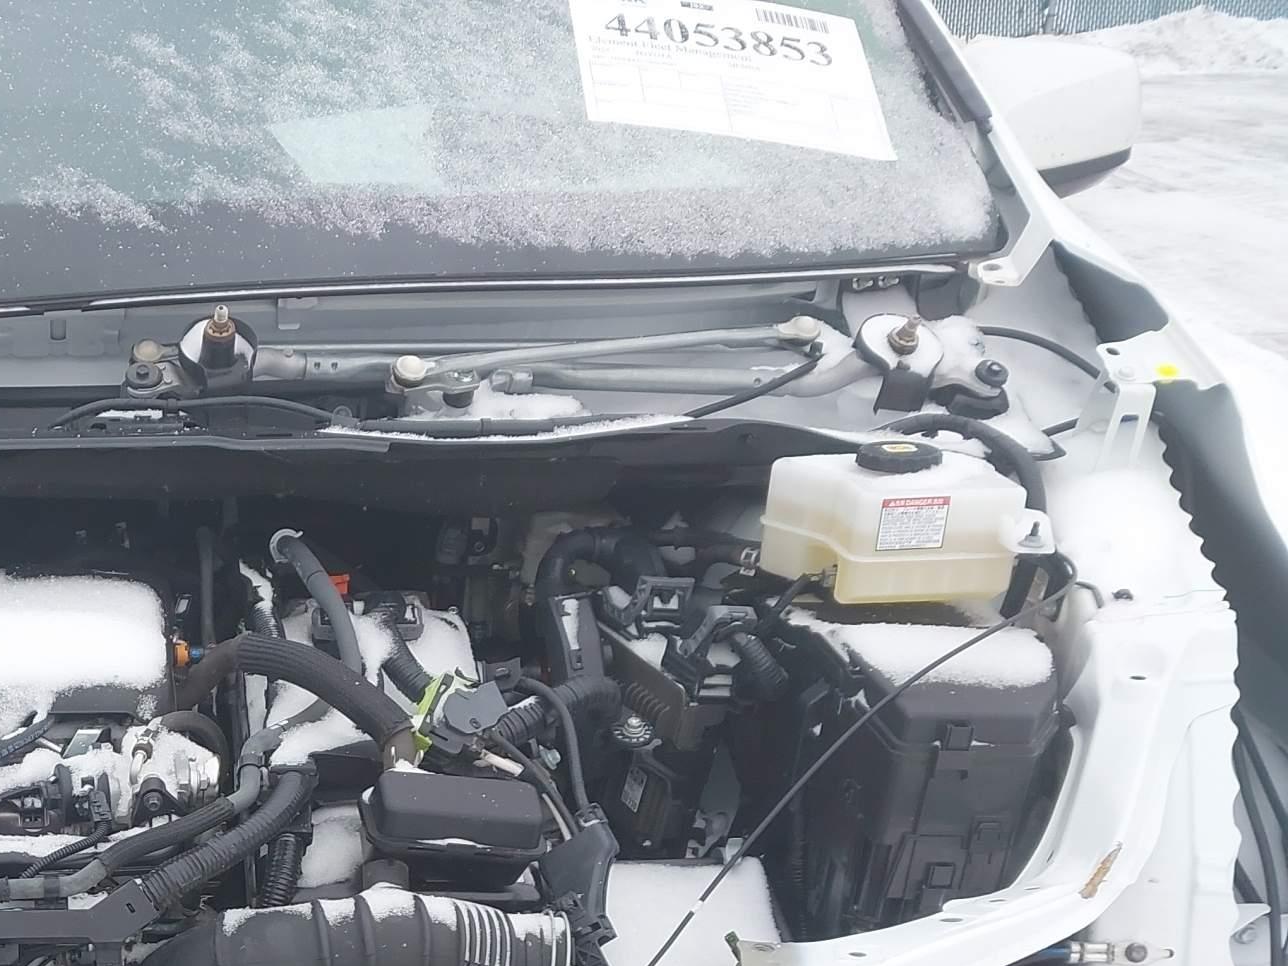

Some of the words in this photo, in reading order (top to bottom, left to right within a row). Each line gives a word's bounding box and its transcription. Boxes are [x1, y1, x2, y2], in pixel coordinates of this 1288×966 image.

[588, 35, 638, 49] Element
[641, 41, 672, 52] Fleet
[675, 44, 752, 63] Management
[605, 13, 833, 67] 44053853
